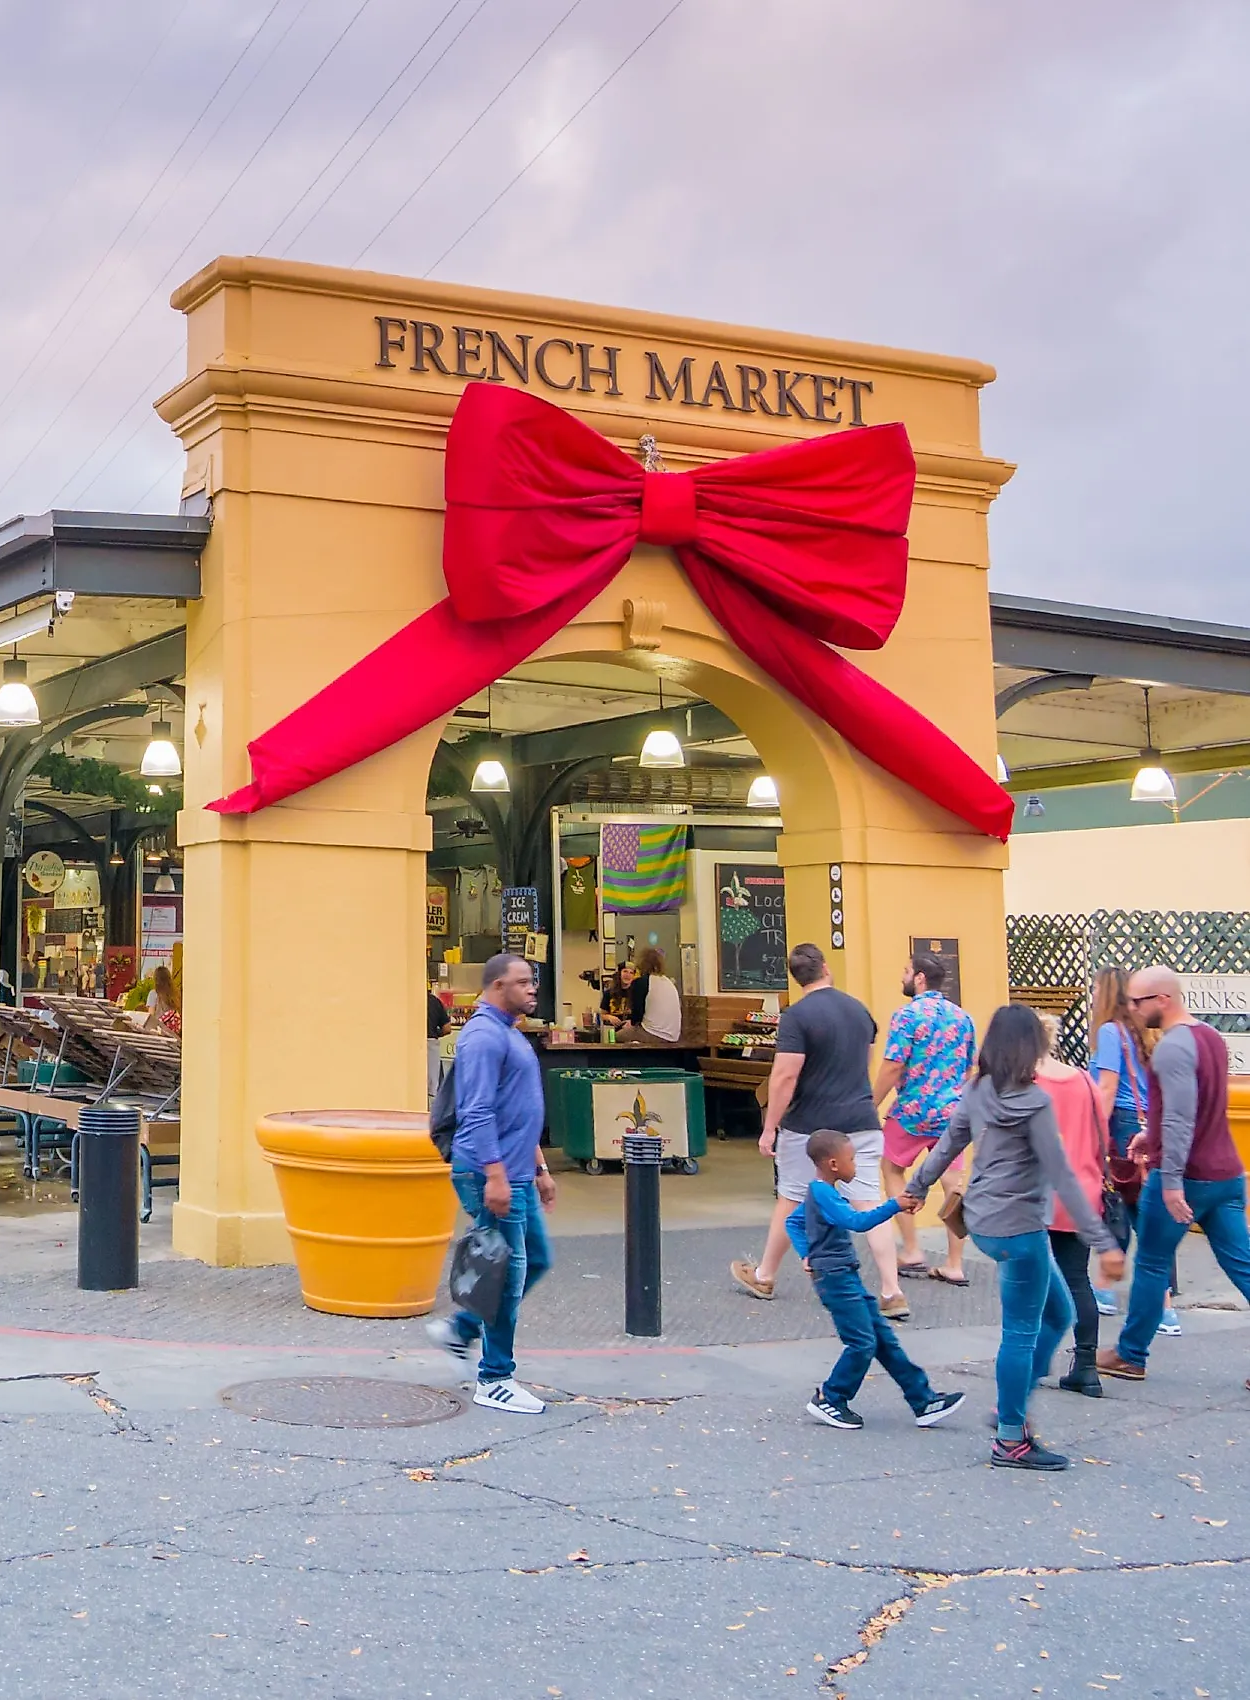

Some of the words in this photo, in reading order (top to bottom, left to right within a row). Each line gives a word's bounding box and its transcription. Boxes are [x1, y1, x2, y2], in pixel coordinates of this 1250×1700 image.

[374, 316, 623, 396] FRENCH
[645, 351, 874, 427] MARKET
[510, 896, 526, 908] ICE
[754, 895, 785, 907] LOC
[507, 911, 530, 923] CREAM
[1190, 979, 1225, 990] COLD
